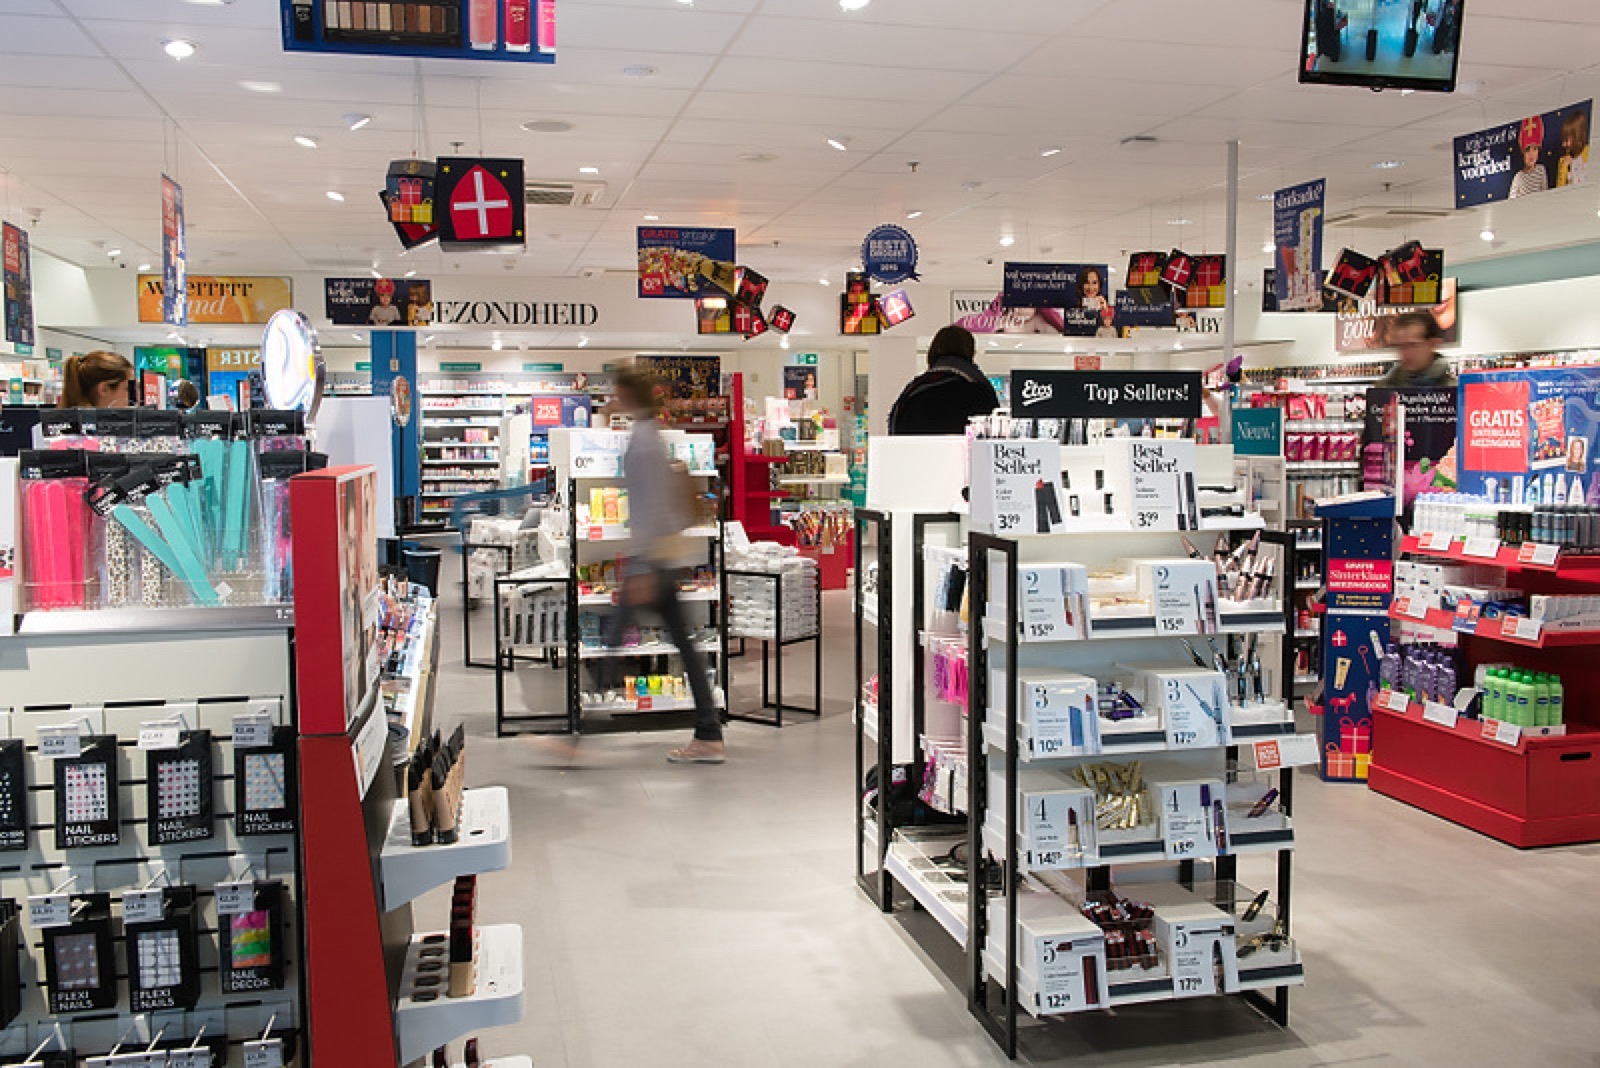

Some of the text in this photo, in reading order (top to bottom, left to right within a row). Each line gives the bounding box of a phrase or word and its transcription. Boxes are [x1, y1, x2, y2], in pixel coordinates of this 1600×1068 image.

[430, 302, 598, 325] EZONDHEID
[1022, 379, 1053, 406] Etos
[1083, 383, 1190, 404] Top Sellers!
[1470, 409, 1523, 427] GRATIS
[1236, 421, 1276, 441] Nieuw!
[993, 444, 1027, 459] Best
[1132, 444, 1164, 459] Best
[993, 459, 1042, 475] Seller!
[1132, 458, 1180, 474] Seller!
[997, 513, 1021, 529] 3.99
[1137, 511, 1159, 527] 3.99
[1035, 685, 1049, 710] 3
[1167, 679, 1181, 702] 3
[1166, 789, 1179, 812] 4
[1034, 798, 1048, 822] 4
[157, 820, 185, 833] NAIL
[243, 813, 270, 824] NAIL
[65, 826, 93, 836] NAIL
[244, 821, 294, 833] STICKERS
[65, 834, 119, 847] STICKERS
[158, 828, 209, 843] STICKERS
[1175, 925, 1188, 948] 5
[1043, 940, 1057, 965] 5
[230, 969, 257, 980] NAIL
[230, 977, 270, 990] DECOR
[57, 990, 89, 1001] FLEXI
[139, 988, 171, 1000] FLEXI
[58, 1000, 94, 1011] NAILS
[139, 998, 175, 1010] NAILS
